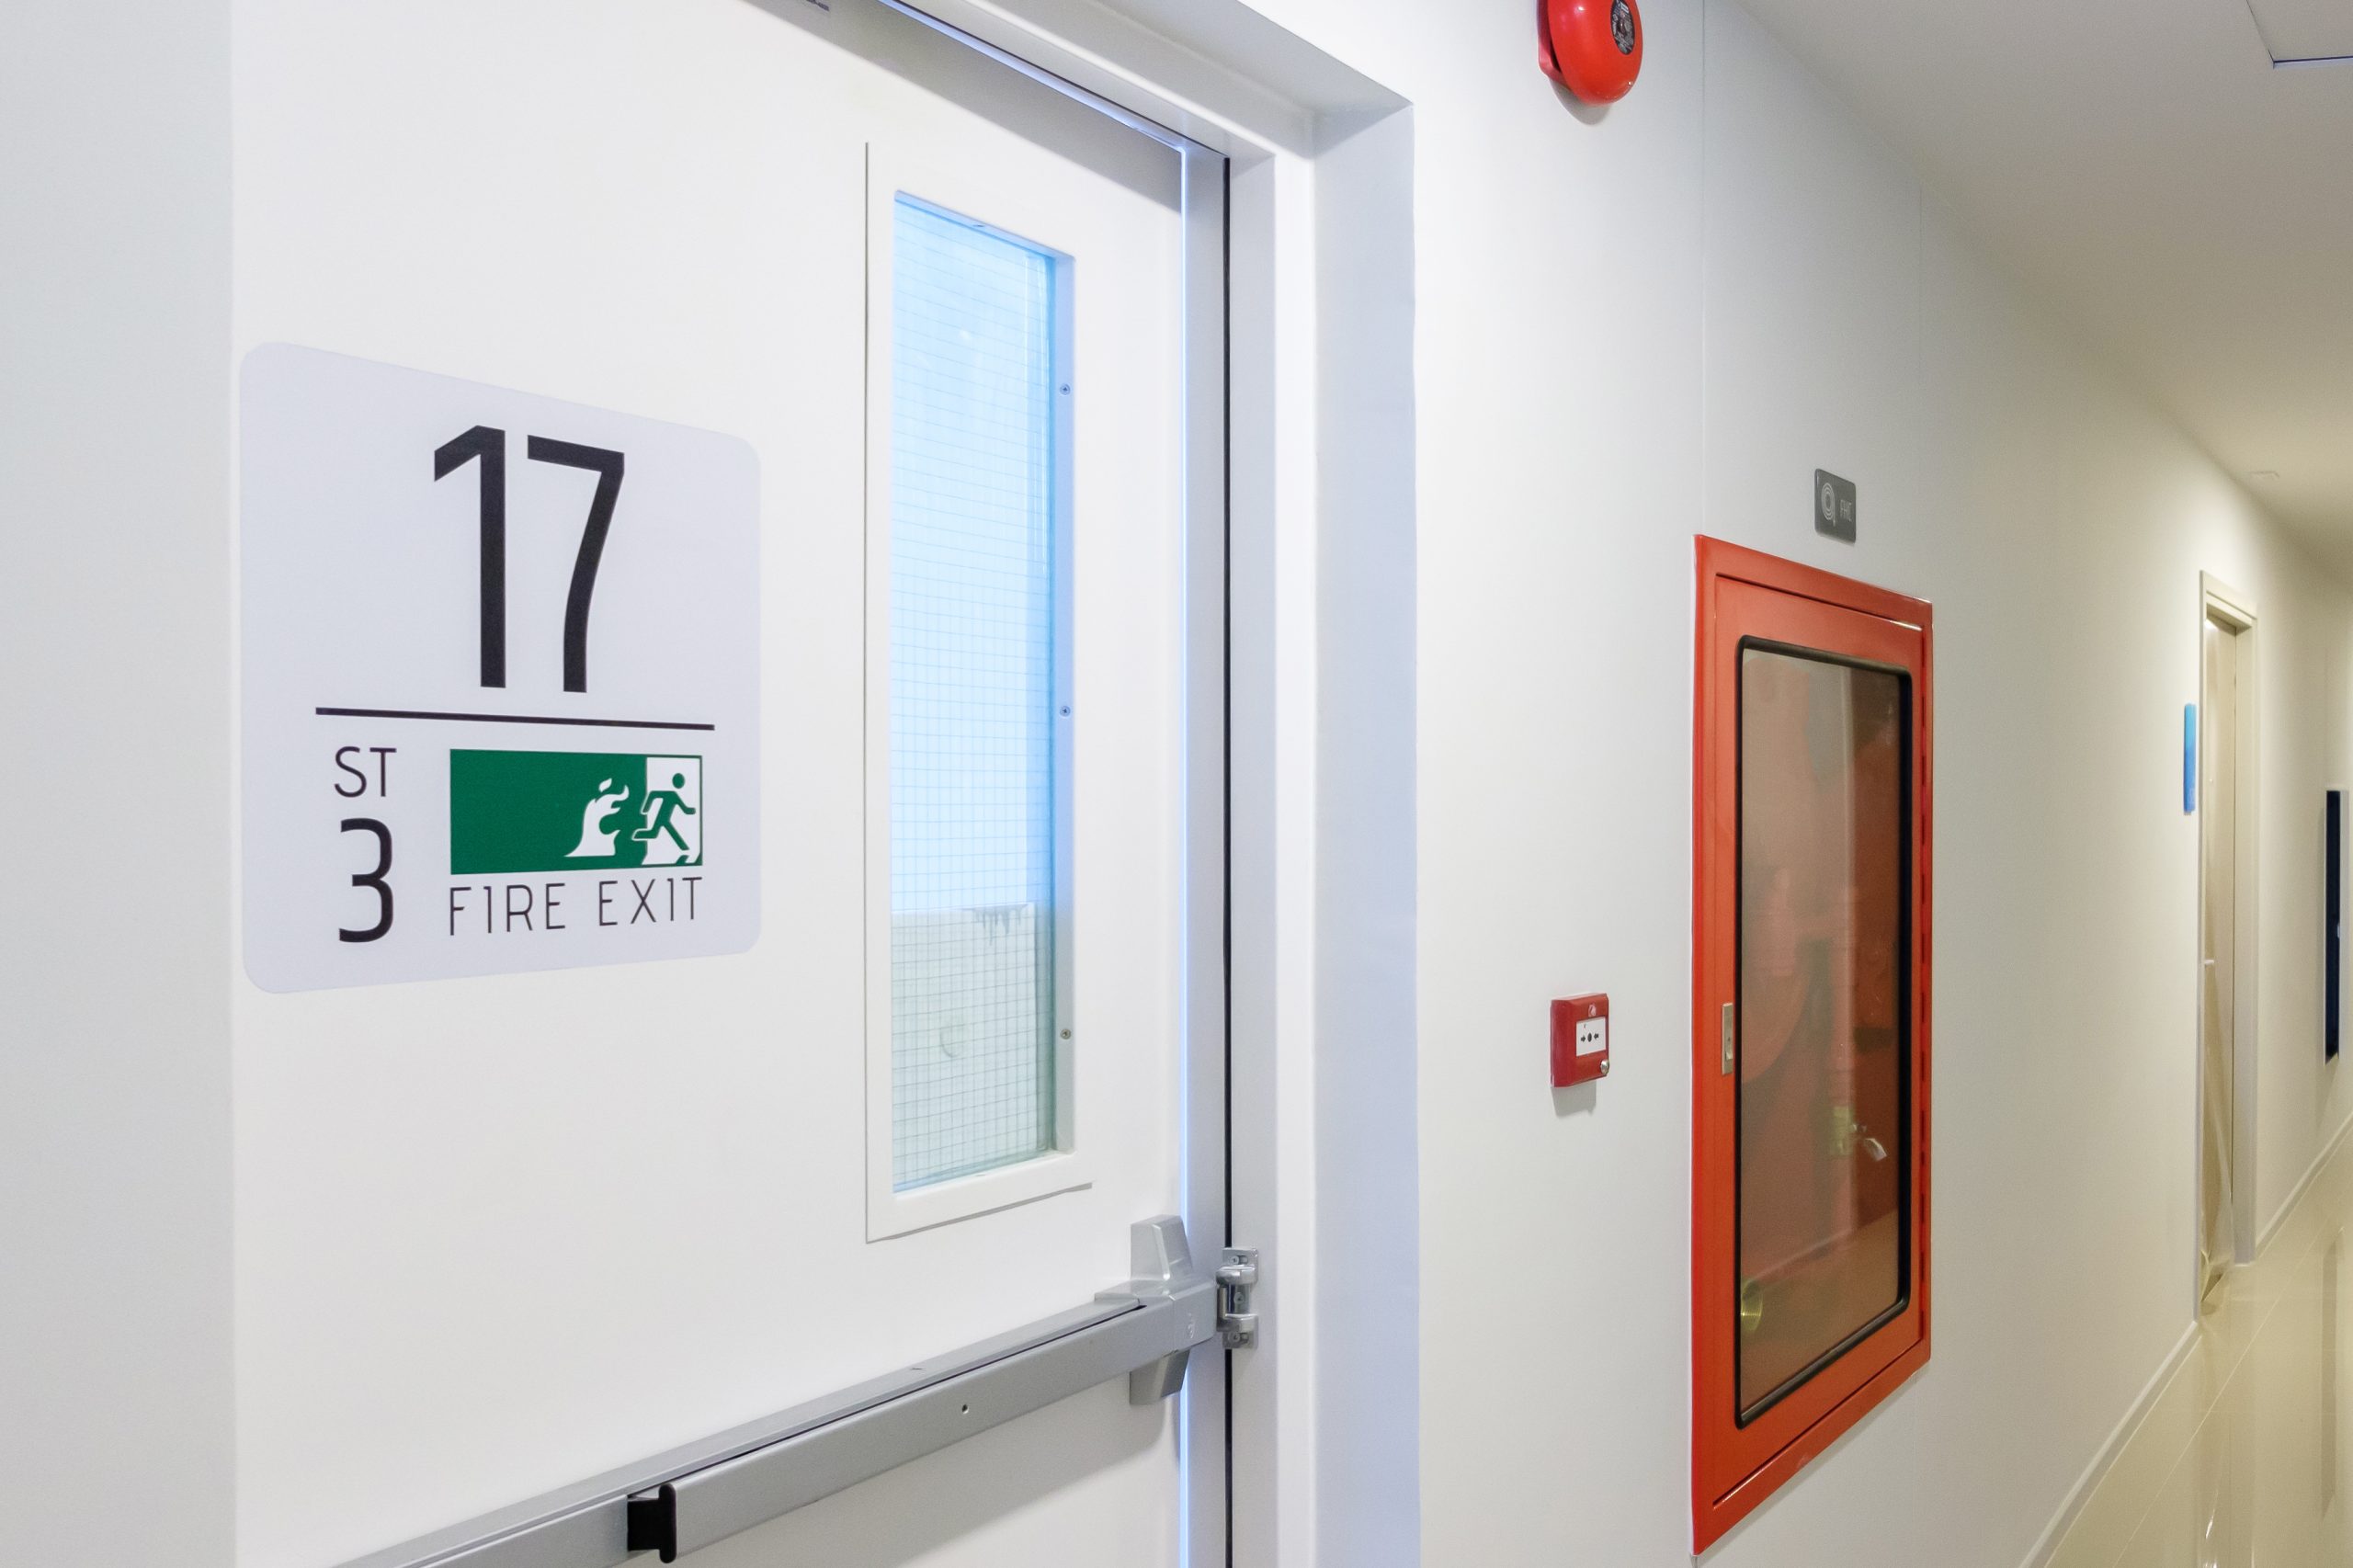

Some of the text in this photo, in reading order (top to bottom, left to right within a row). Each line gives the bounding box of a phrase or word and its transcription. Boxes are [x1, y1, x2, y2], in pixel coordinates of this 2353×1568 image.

[434, 425, 625, 693] 17
[333, 745, 398, 798] ST
[338, 817, 394, 943] 3
[449, 875, 703, 937] FIRE EXIT
